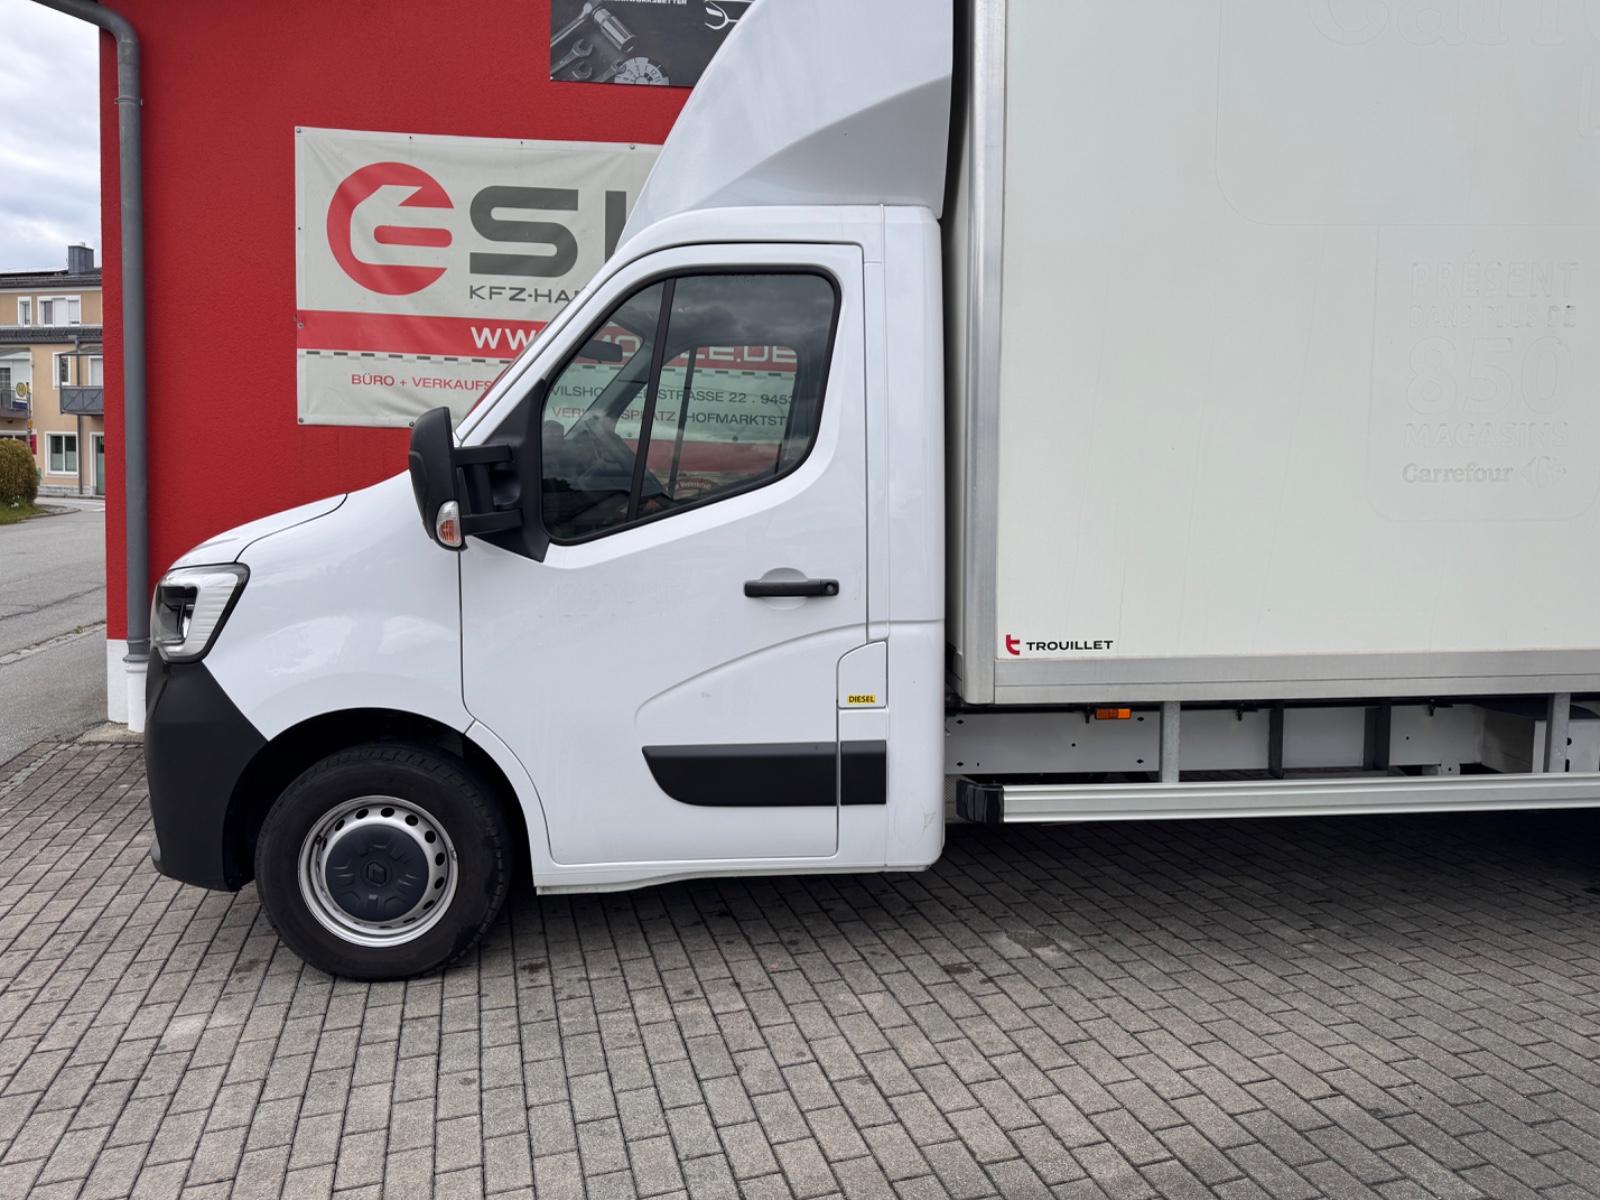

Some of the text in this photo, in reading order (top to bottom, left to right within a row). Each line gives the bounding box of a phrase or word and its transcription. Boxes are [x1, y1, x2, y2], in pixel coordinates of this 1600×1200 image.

[470, 285, 581, 303] KFZ-HA
[351, 373, 395, 387] BÜRO
[728, 392, 747, 403] 22
[760, 393, 792, 405] 945
[1401, 462, 1514, 484] Carrefour
[1026, 640, 1114, 651] TROUILLET
[848, 695, 876, 703] DIESEL
